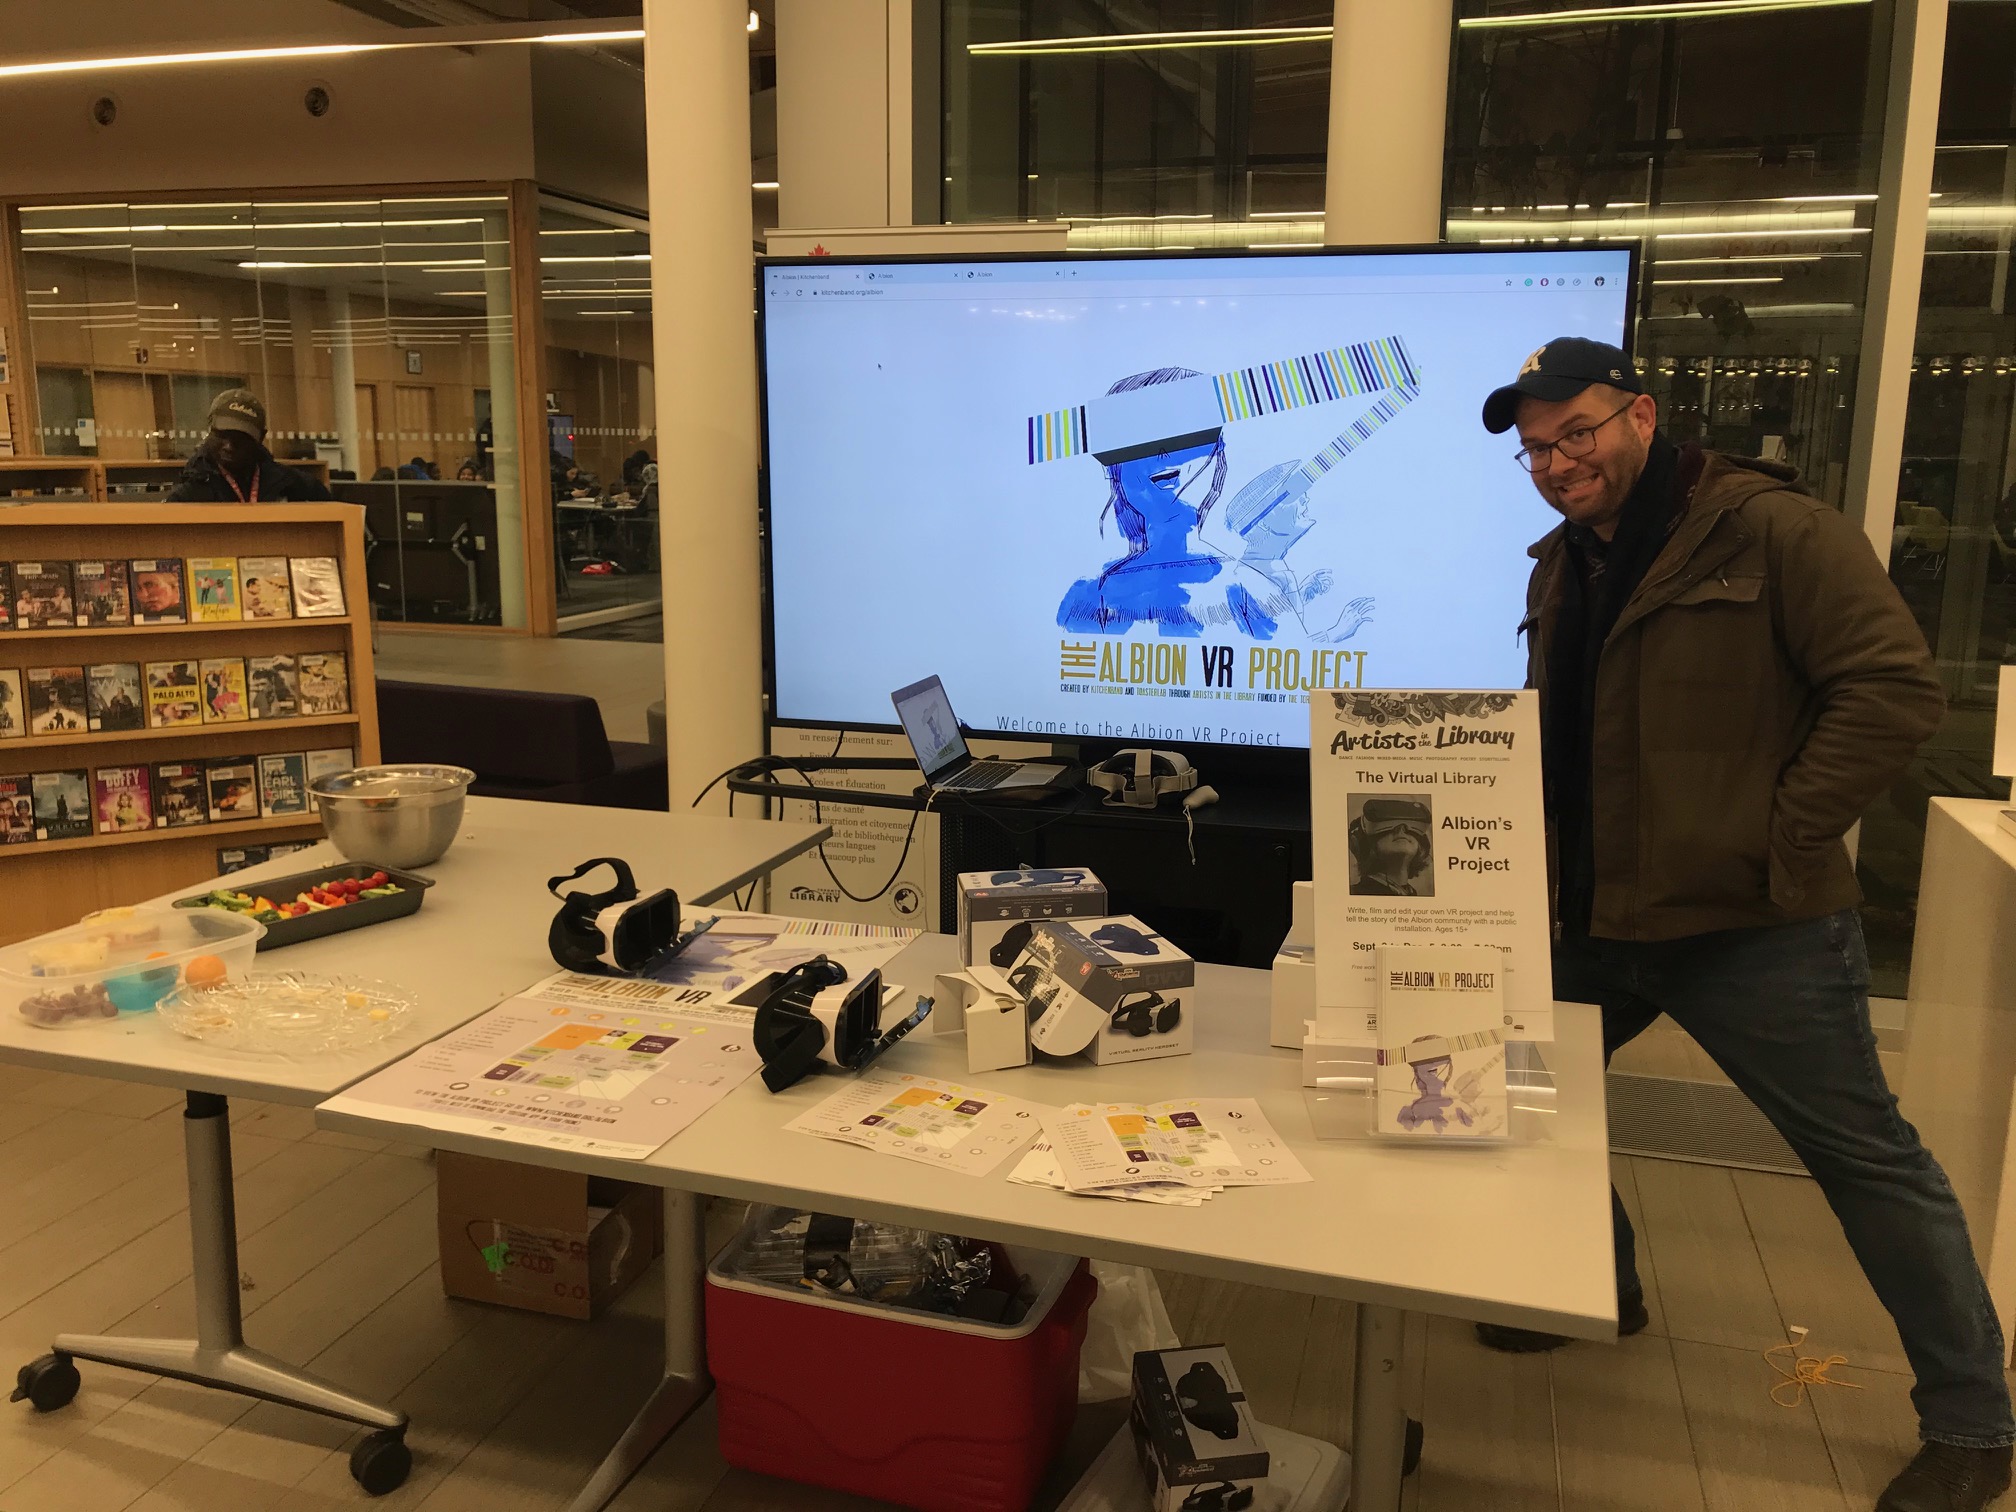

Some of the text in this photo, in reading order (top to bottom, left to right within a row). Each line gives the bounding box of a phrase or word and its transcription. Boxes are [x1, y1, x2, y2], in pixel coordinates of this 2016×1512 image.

[1061, 640, 1368, 690] THE ALBION VR PROJECT
[153, 689, 195, 700] PALO ALTO
[1060, 684, 1080, 693] CREATED
[1082, 685, 1089, 693] BY
[1091, 685, 1123, 695] KITCHENBAND
[1125, 687, 1134, 695] AND
[1136, 687, 1166, 696] TOASTERLAB
[1169, 689, 1190, 698] THROUGH
[1192, 690, 1213, 699] ARTISTS
[1223, 692, 1232, 700] THE
[1234, 692, 1255, 701] LIBRARY
[1258, 693, 1276, 702] FUNDED
[1279, 693, 1286, 703] BY
[1289, 694, 1298, 703] THE
[996, 716, 1281, 746] Welcome to the Albion VR Project
[812, 734, 874, 745] renseinement
[876, 738, 893, 746] sur:
[1330, 730, 1417, 755] Artists
[1418, 739, 1432, 747] the
[1434, 726, 1515, 750] Library
[845, 778, 886, 790] Éducation
[1356, 771, 1496, 787] The Virtual Library
[832, 804, 841, 812] de
[843, 805, 865, 814] santé
[1441, 816, 1513, 831] Albion's
[854, 831, 904, 844] bibliothèque
[1465, 836, 1490, 850] VR
[846, 842, 876, 851] langues
[808, 851, 817, 859] Et
[858, 855, 875, 864] plus
[1449, 857, 1510, 874] Project
[790, 893, 840, 902] LIBRARY
[1460, 909, 1483, 917] project
[1434, 918, 1472, 926] community
[1496, 918, 1517, 926] public
[1391, 971, 1494, 988] THE ALBION VR PROJECT
[586, 980, 674, 1000] ALBION
[674, 989, 712, 1004] VR
